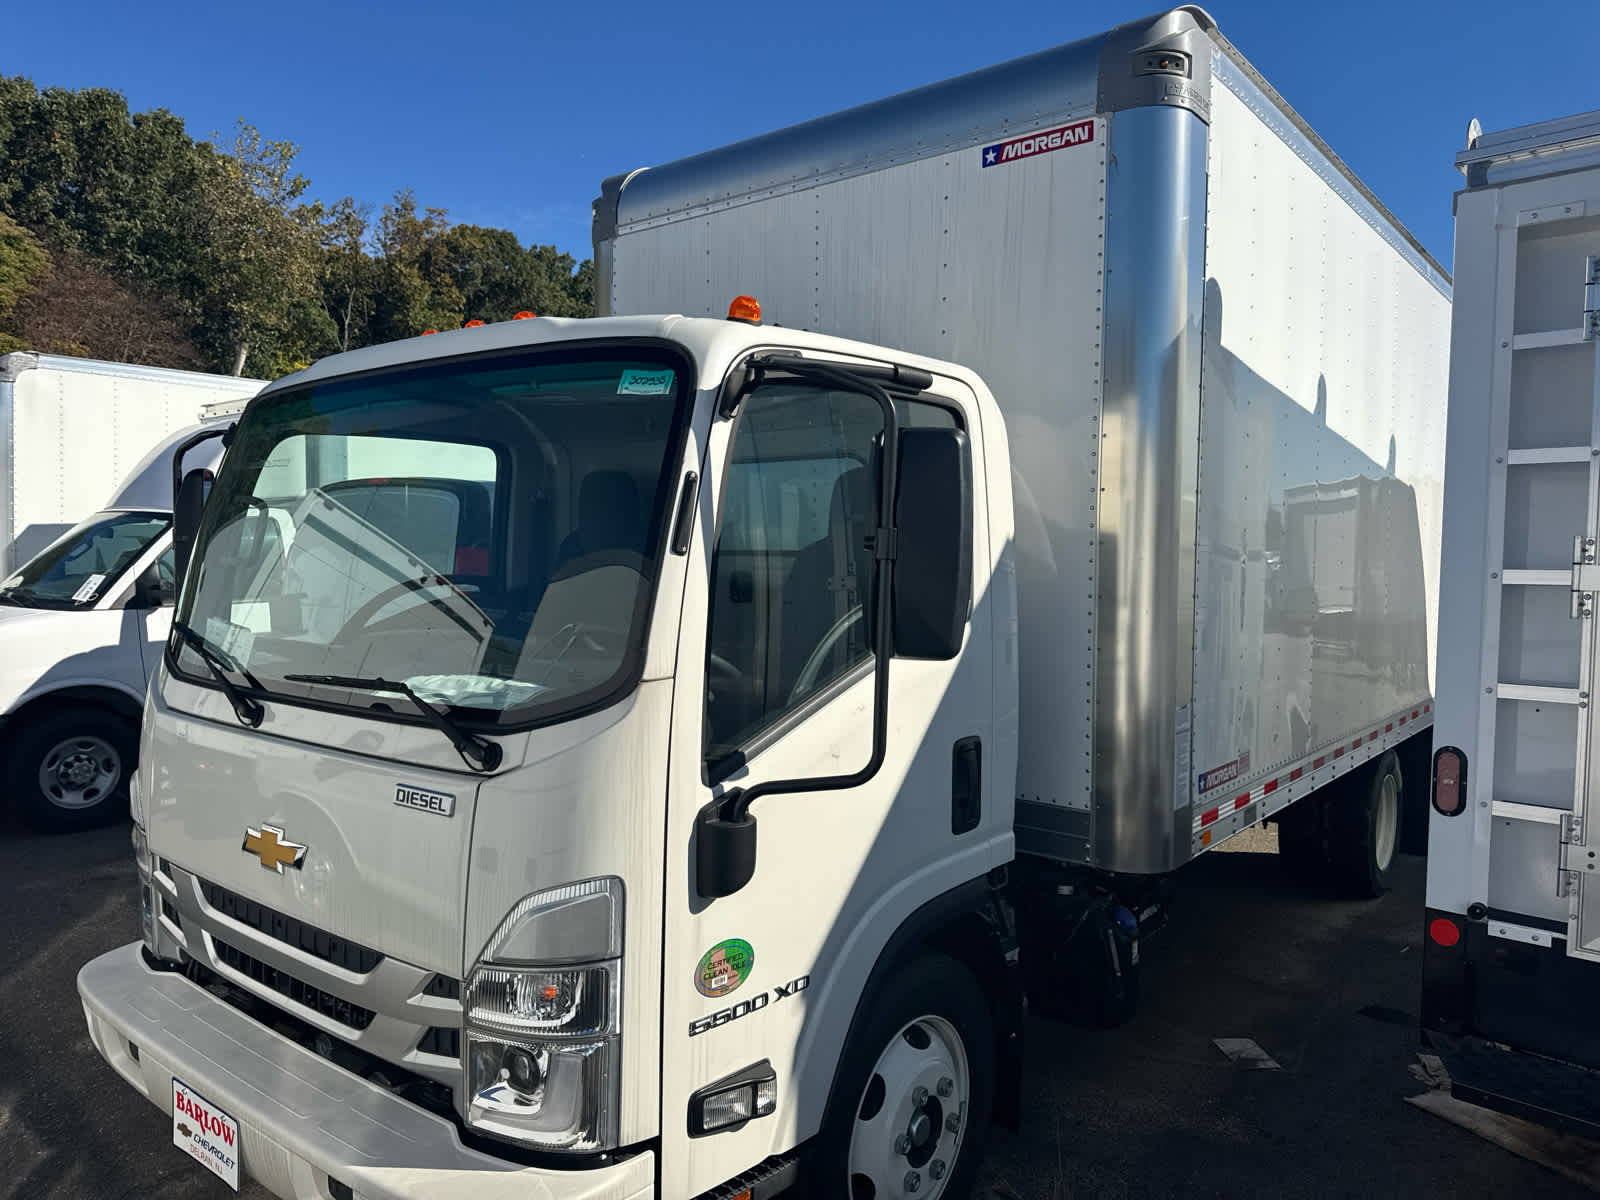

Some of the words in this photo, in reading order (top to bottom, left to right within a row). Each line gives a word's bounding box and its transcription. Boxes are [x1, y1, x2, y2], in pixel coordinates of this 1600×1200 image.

[1002, 125, 1090, 160] MORGAN
[1206, 763, 1238, 789] MORGAN
[396, 788, 446, 812] DIESEL
[703, 967, 729, 980] CLEAN
[731, 959, 746, 971] IDLE
[707, 952, 744, 970] CERTIFIED
[688, 992, 769, 1037] 5500
[772, 975, 810, 1003] XD
[176, 1090, 235, 1147] BARLOW
[193, 1133, 236, 1169] CHEVROLET
